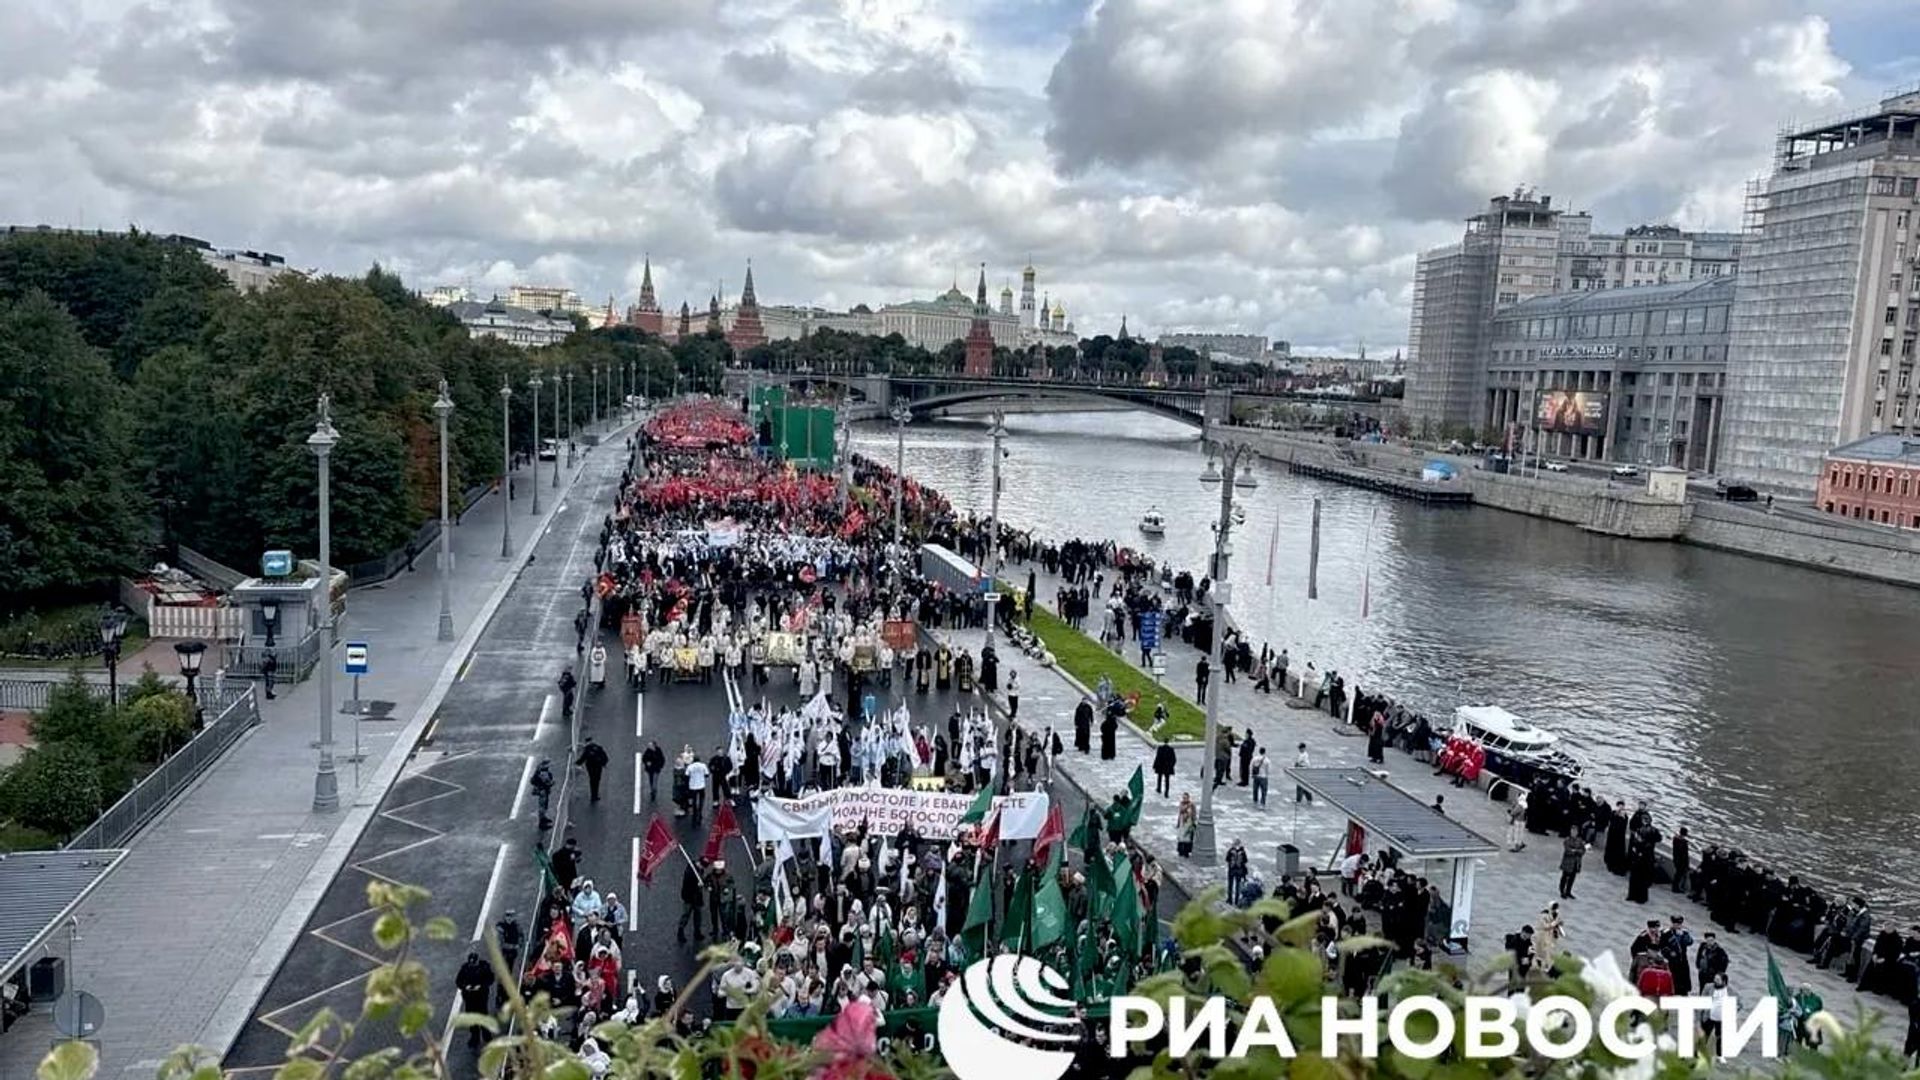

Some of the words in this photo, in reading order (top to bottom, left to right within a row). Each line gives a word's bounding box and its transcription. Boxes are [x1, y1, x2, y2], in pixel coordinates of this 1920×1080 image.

[782, 792, 838, 812] СВЯТЫЙ
[843, 792, 916, 806] АПОСТОЛЕ
[920, 798, 929, 808] И
[832, 806, 886, 818] ИОАННЕ
[932, 827, 960, 838] НАС
